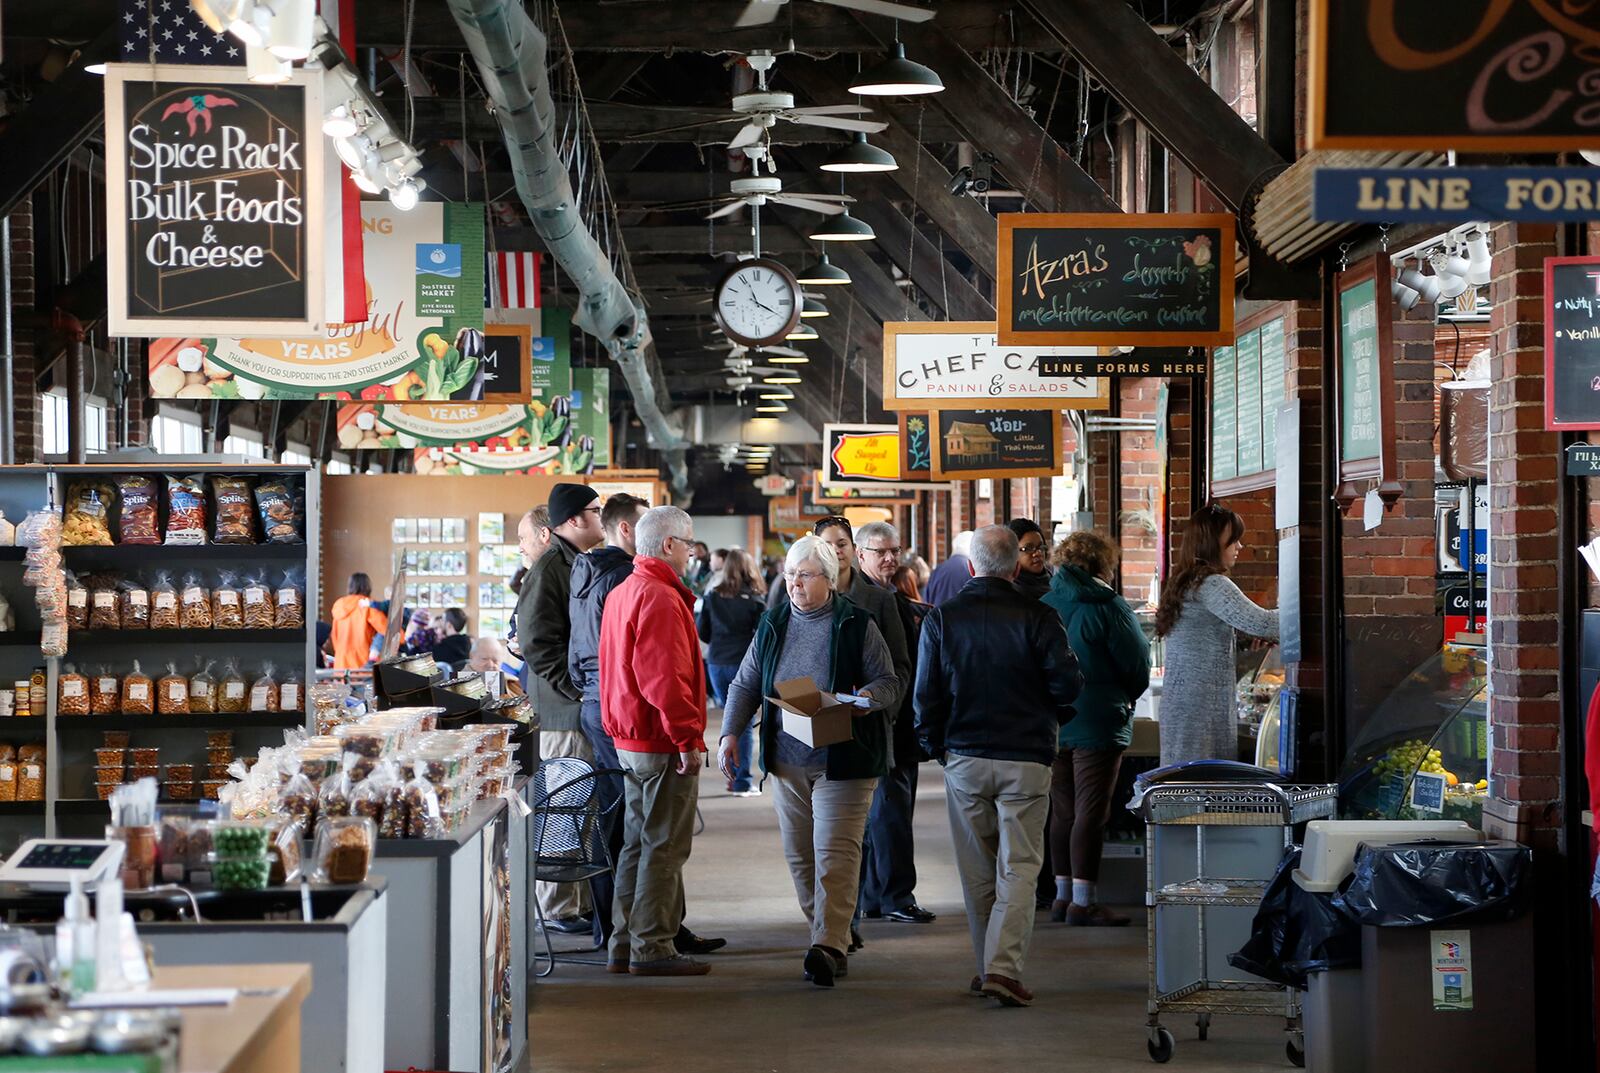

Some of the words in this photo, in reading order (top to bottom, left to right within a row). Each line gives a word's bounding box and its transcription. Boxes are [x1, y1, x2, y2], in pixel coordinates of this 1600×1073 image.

[128, 124, 217, 186] Spice
[220, 126, 302, 170] Rack
[128, 180, 206, 221] Bulk
[214, 179, 302, 225] Foods
[1357, 178, 1471, 210] LINE
[1505, 178, 1600, 210] FOR
[202, 224, 217, 244] &
[361, 217, 393, 234] NG
[146, 232, 263, 268] Cheese
[1019, 236, 1109, 300] Azra's
[1018, 292, 1149, 327] mediterranean
[1157, 304, 1207, 326] cuisine
[1565, 296, 1593, 318] Nutty
[1566, 326, 1600, 340] Vanill
[281, 341, 352, 360] YEARS
[482, 350, 498, 368] M
[228, 352, 251, 368] THANK
[252, 361, 267, 373] YOU
[267, 366, 281, 376] FOR
[282, 370, 327, 381] SUPPORTING
[328, 371, 343, 380] THE
[343, 369, 358, 379] 2ND
[357, 362, 383, 376] STREET
[382, 350, 410, 368] MARKET
[898, 352, 987, 388] CHEF
[1003, 352, 1087, 388] CAE
[1044, 363, 1084, 373] LINE
[1097, 363, 1150, 373] FORMS
[1163, 364, 1205, 373] HERE
[927, 383, 983, 393] PANINI
[989, 374, 1005, 396] &
[1008, 383, 1069, 393] SALADS
[428, 406, 478, 421] YEARS
[1575, 452, 1589, 461] I'll
[124, 495, 148, 506] Splits
[219, 495, 246, 504] Splits
